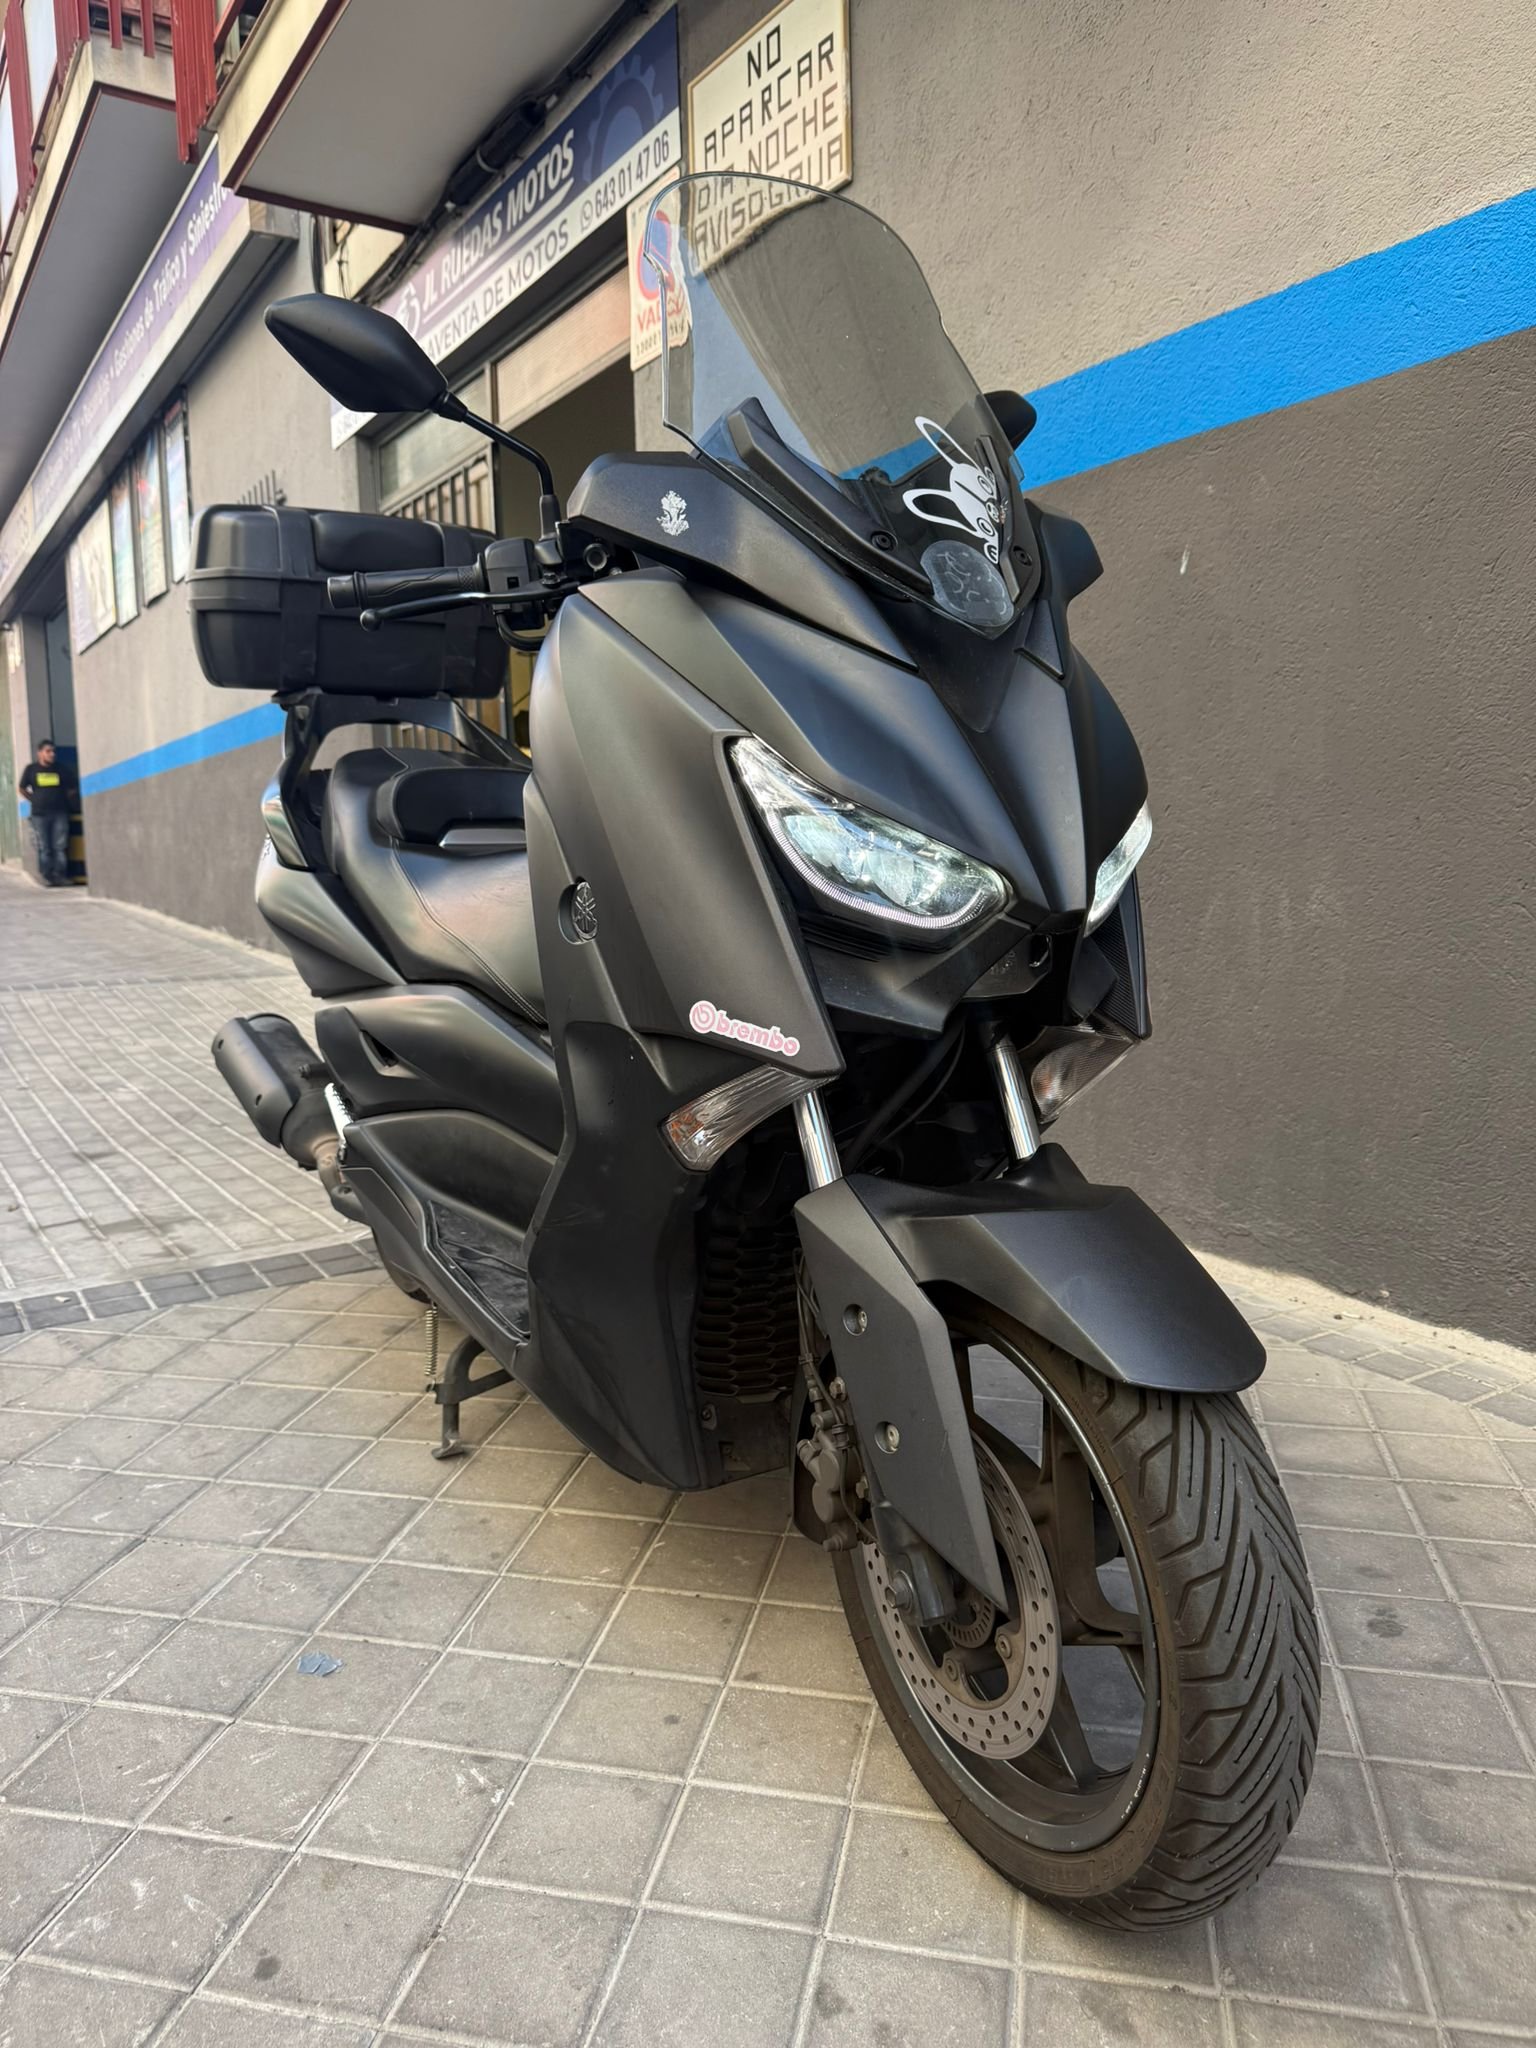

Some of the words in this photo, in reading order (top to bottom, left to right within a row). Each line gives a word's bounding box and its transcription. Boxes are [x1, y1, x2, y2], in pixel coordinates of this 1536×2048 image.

[703, 31, 834, 170] APARCAR
[747, 24, 782, 87] NO
[746, 82, 838, 187] NOCHE
[187, 181, 232, 256] Siniestro
[427, 300, 480, 360] AVENTA
[483, 276, 504, 318] DE
[508, 218, 569, 297] MOTOS
[594, 176, 616, 219] 643
[618, 164, 632, 203] 01
[634, 141, 652, 188] 47
[653, 129, 670, 169] 06
[440, 202, 504, 293] RUEDAS
[506, 128, 574, 235] MOTOS
[715, 1010, 800, 1056] brembo
